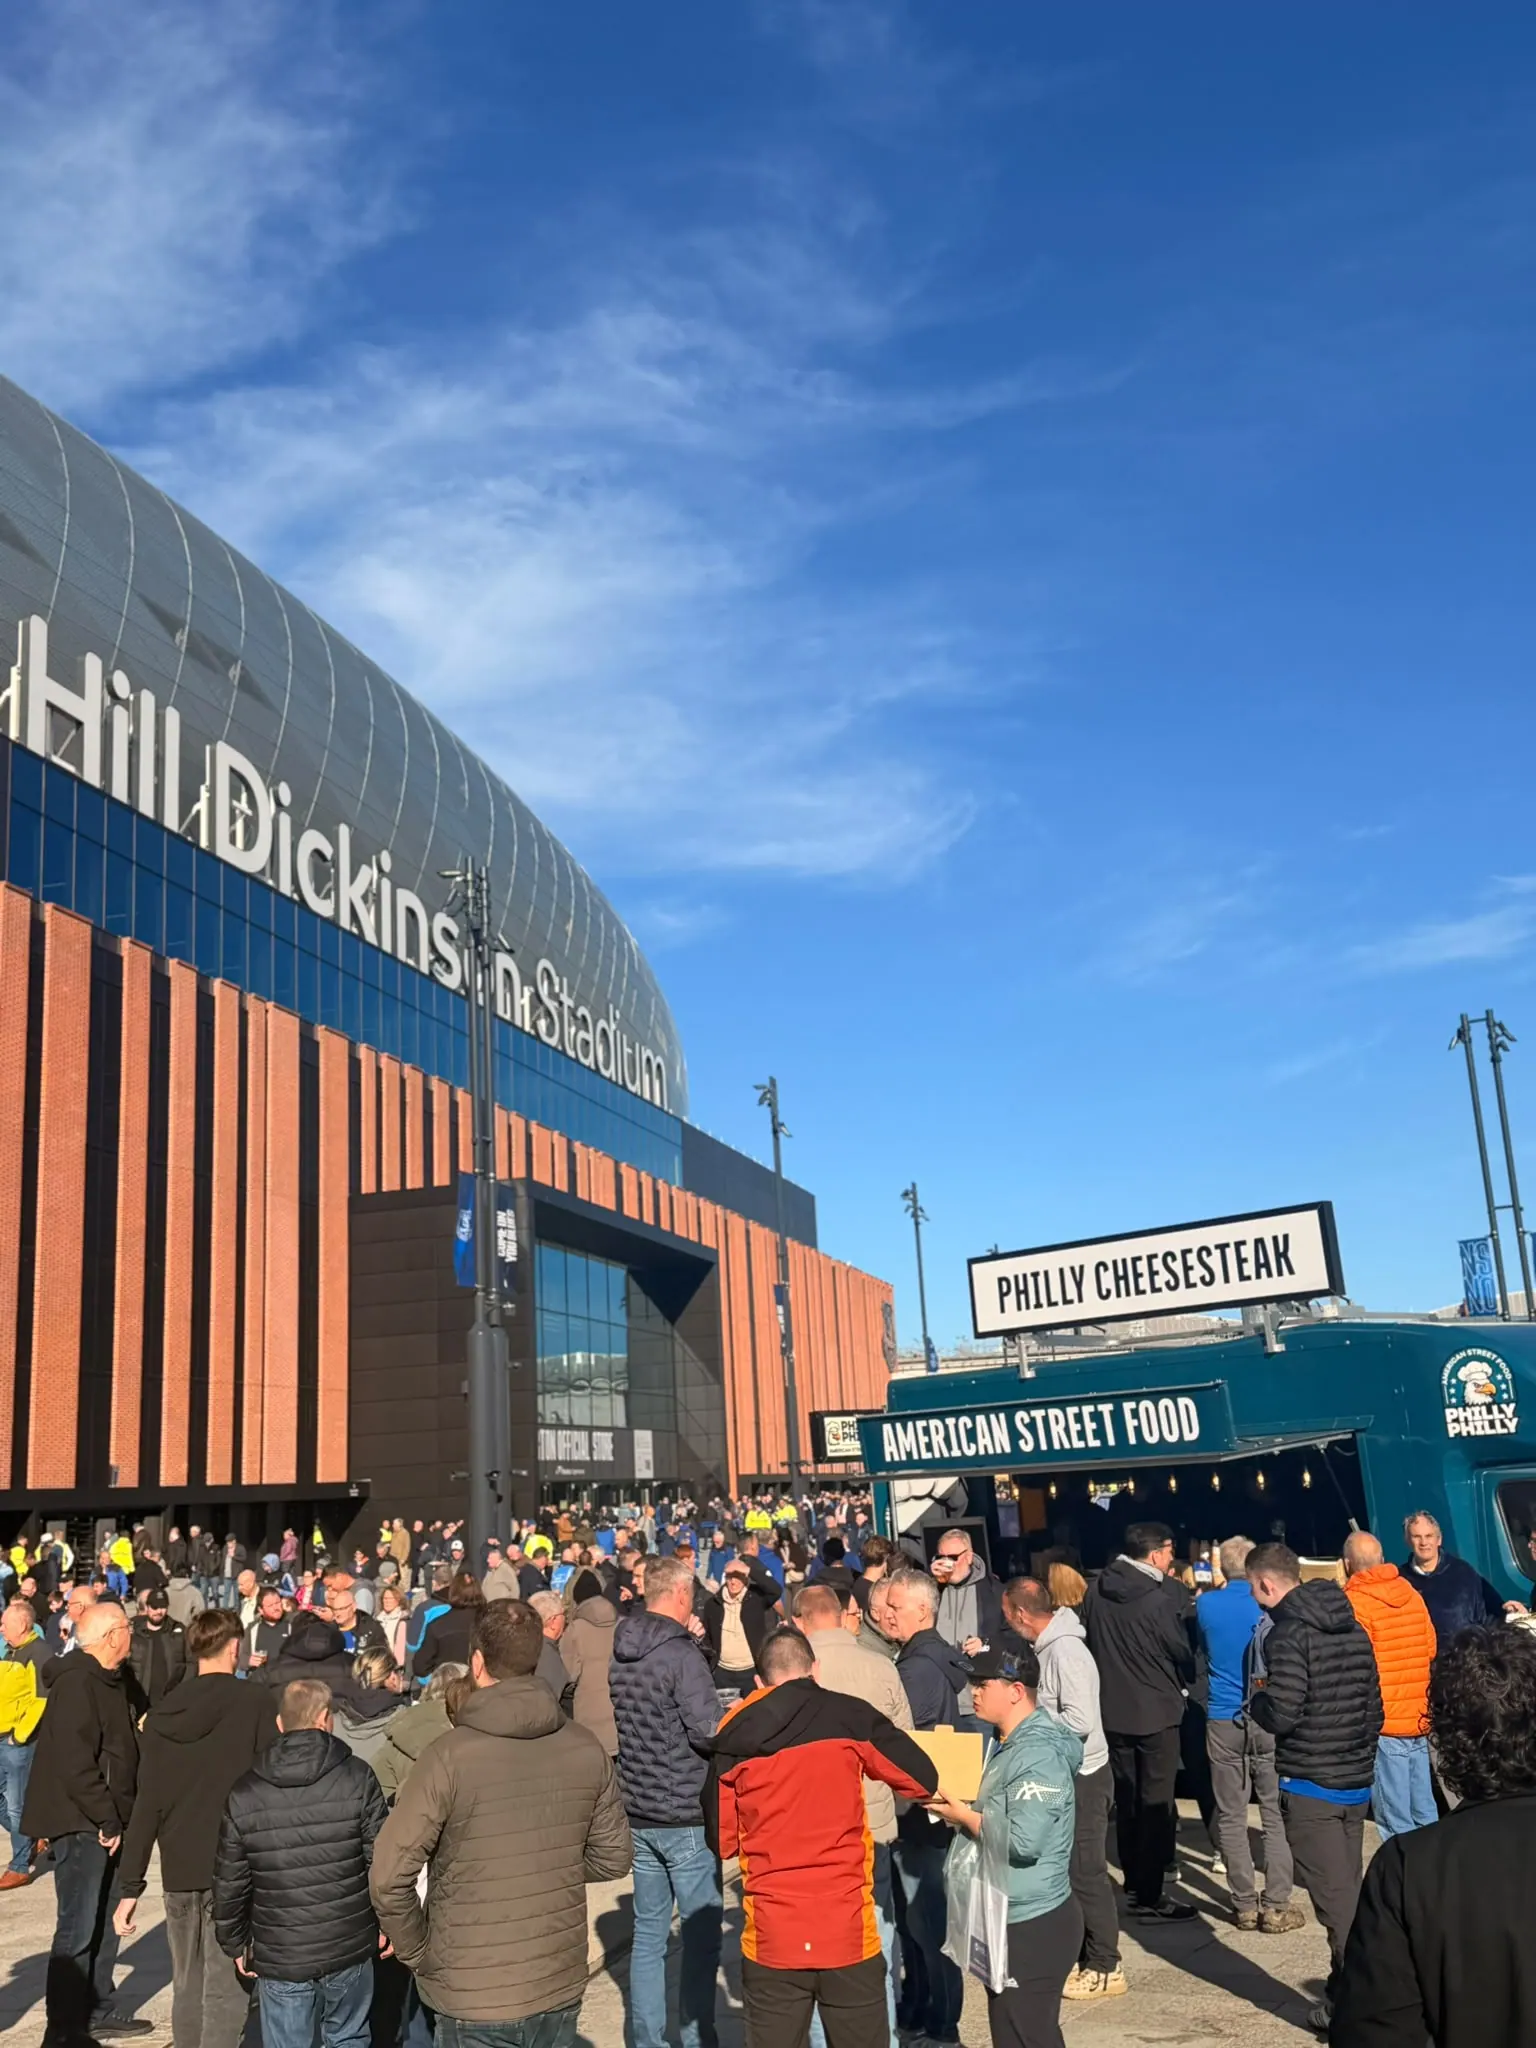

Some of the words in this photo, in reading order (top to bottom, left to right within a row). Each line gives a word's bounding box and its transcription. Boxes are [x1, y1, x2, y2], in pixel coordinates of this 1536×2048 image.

[24, 614, 181, 834] Hill
[536, 957, 668, 1111] Stadium
[504, 1241, 518, 1262] YOU
[996, 1263, 1086, 1314] PHILLY
[1094, 1232, 1296, 1301] CHEESESTEAK
[1441, 1350, 1467, 1386] AMERICAN
[1466, 1347, 1498, 1361] STREET
[1495, 1359, 1512, 1380] FOOD
[881, 1412, 1012, 1462] AMERICAN
[1014, 1403, 1117, 1453] STREET
[1122, 1396, 1200, 1446] FOOD
[1445, 1403, 1516, 1422] PHILLY
[1447, 1417, 1519, 1438] PHILLY
